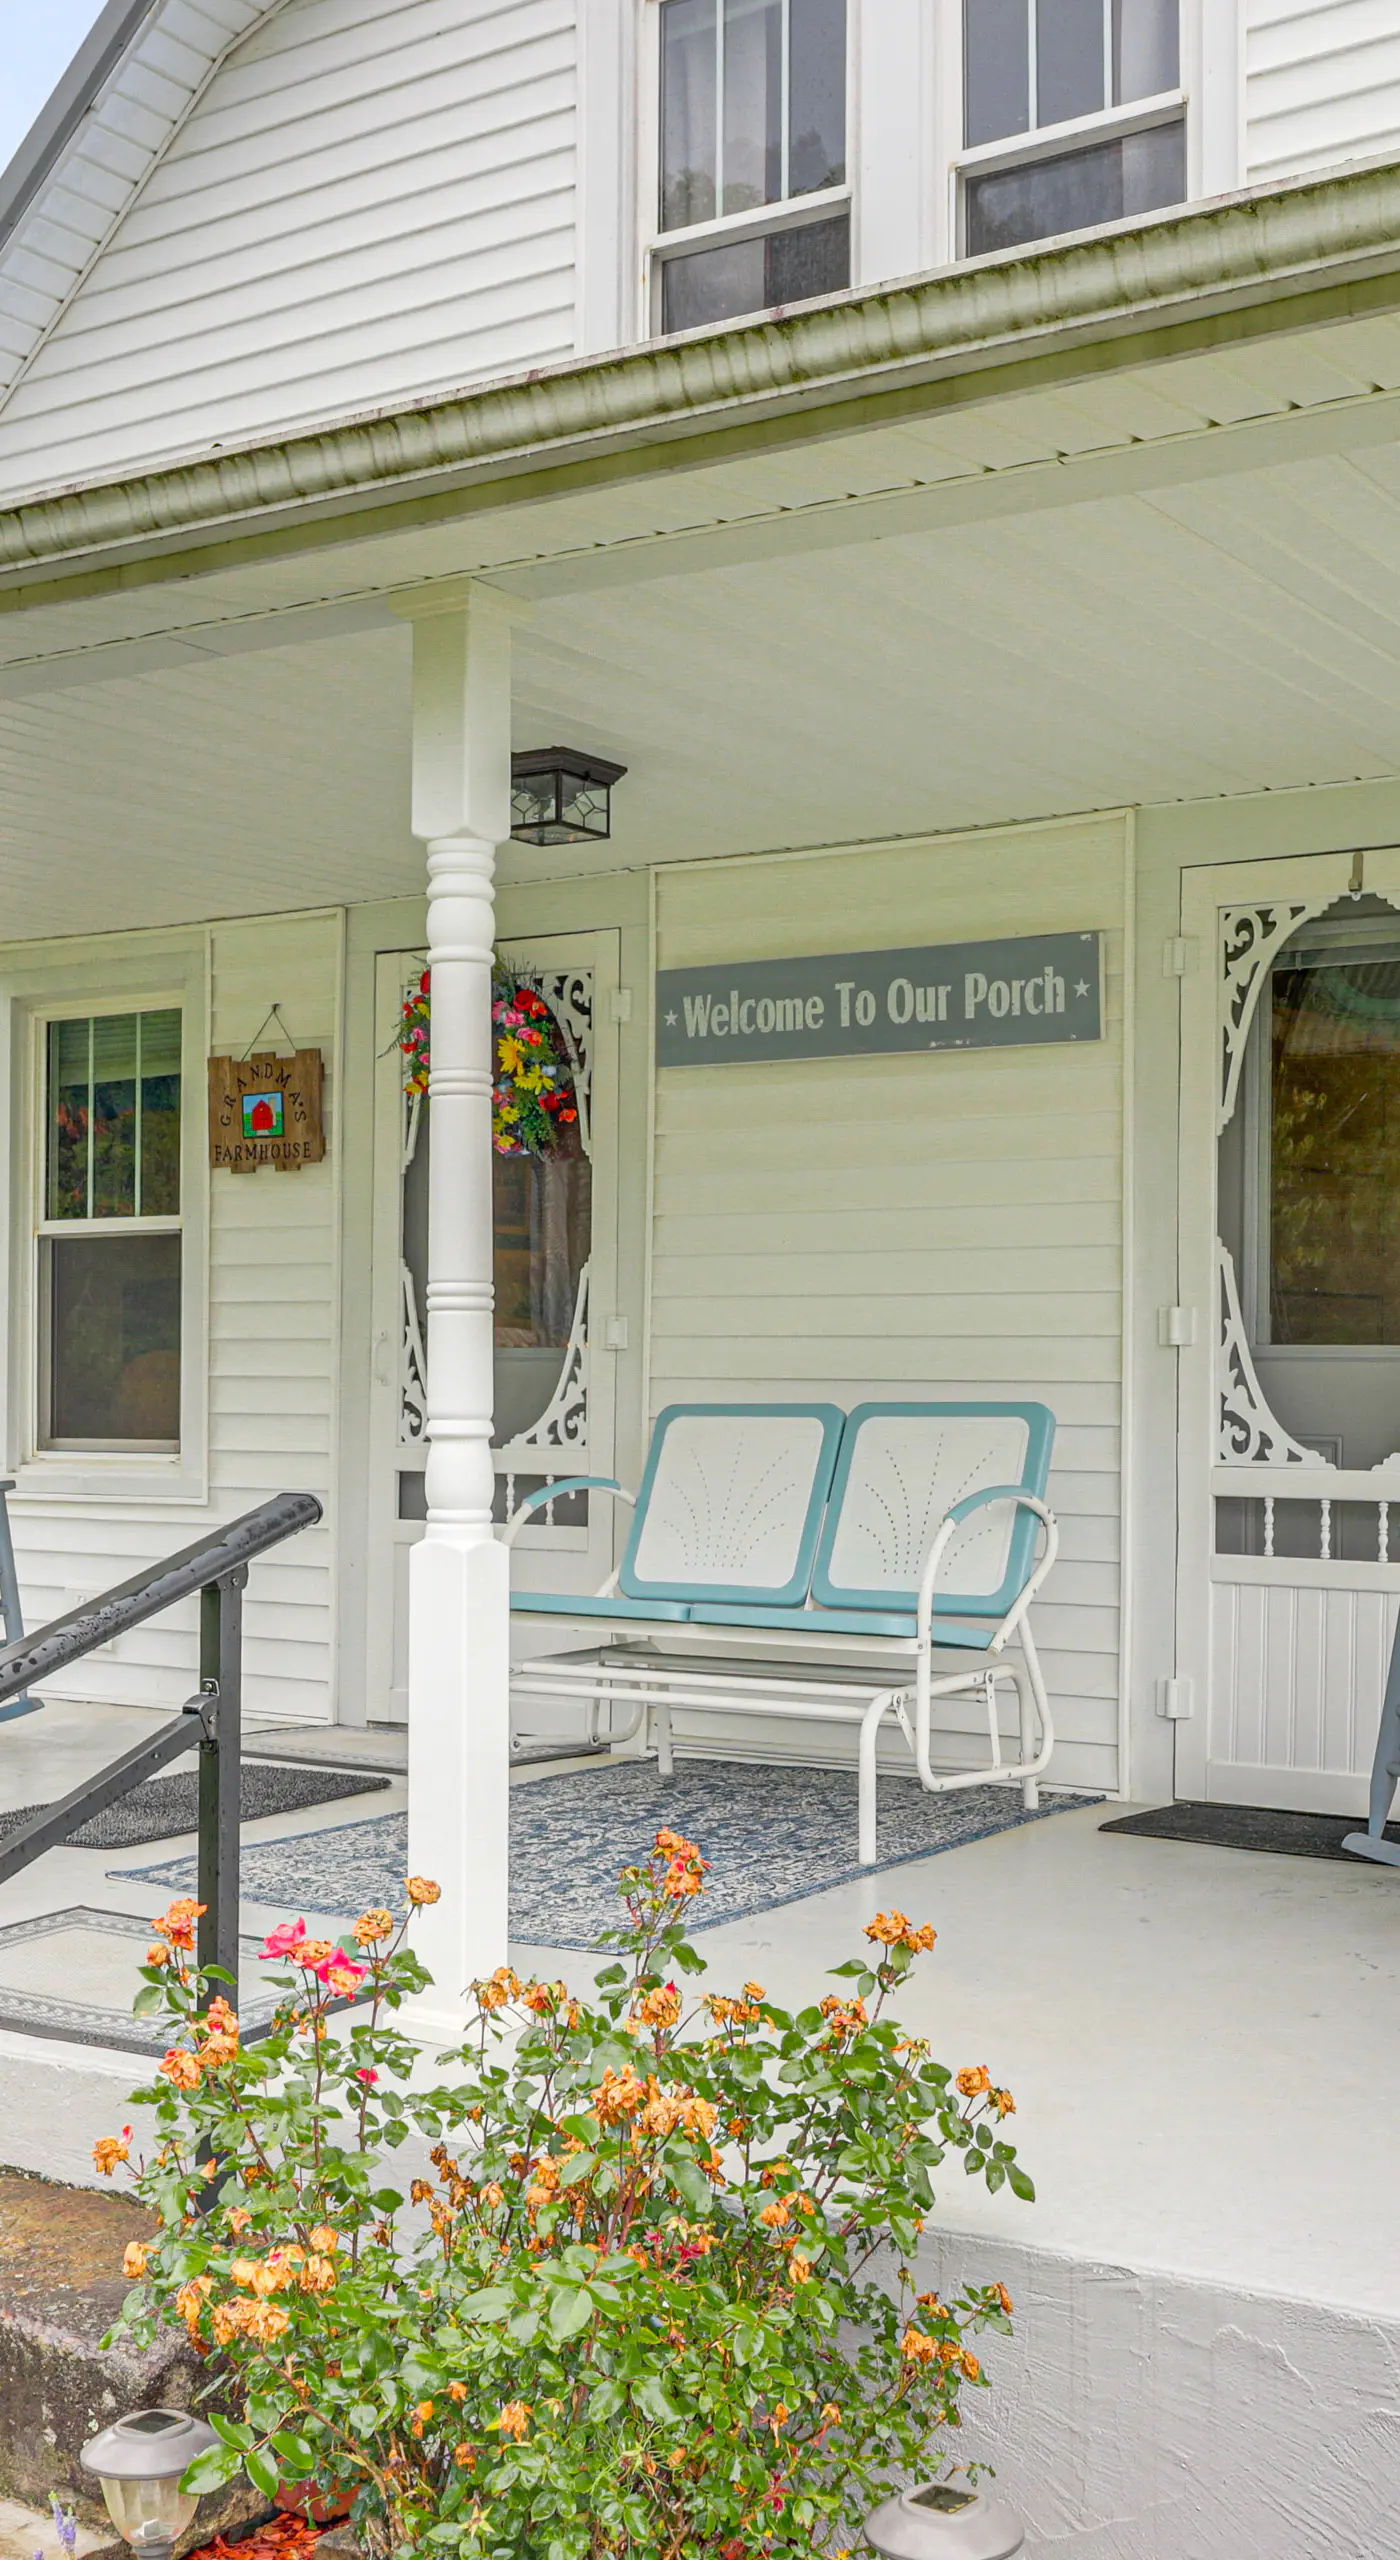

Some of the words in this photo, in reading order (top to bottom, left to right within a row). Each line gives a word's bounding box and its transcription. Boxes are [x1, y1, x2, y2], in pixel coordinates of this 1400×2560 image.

[683, 990, 824, 1038] Welcome
[835, 981, 876, 1028] To
[887, 978, 952, 1024] Our
[964, 966, 1065, 1020] Porch
[214, 1141, 312, 1161] FARMHOUSE
